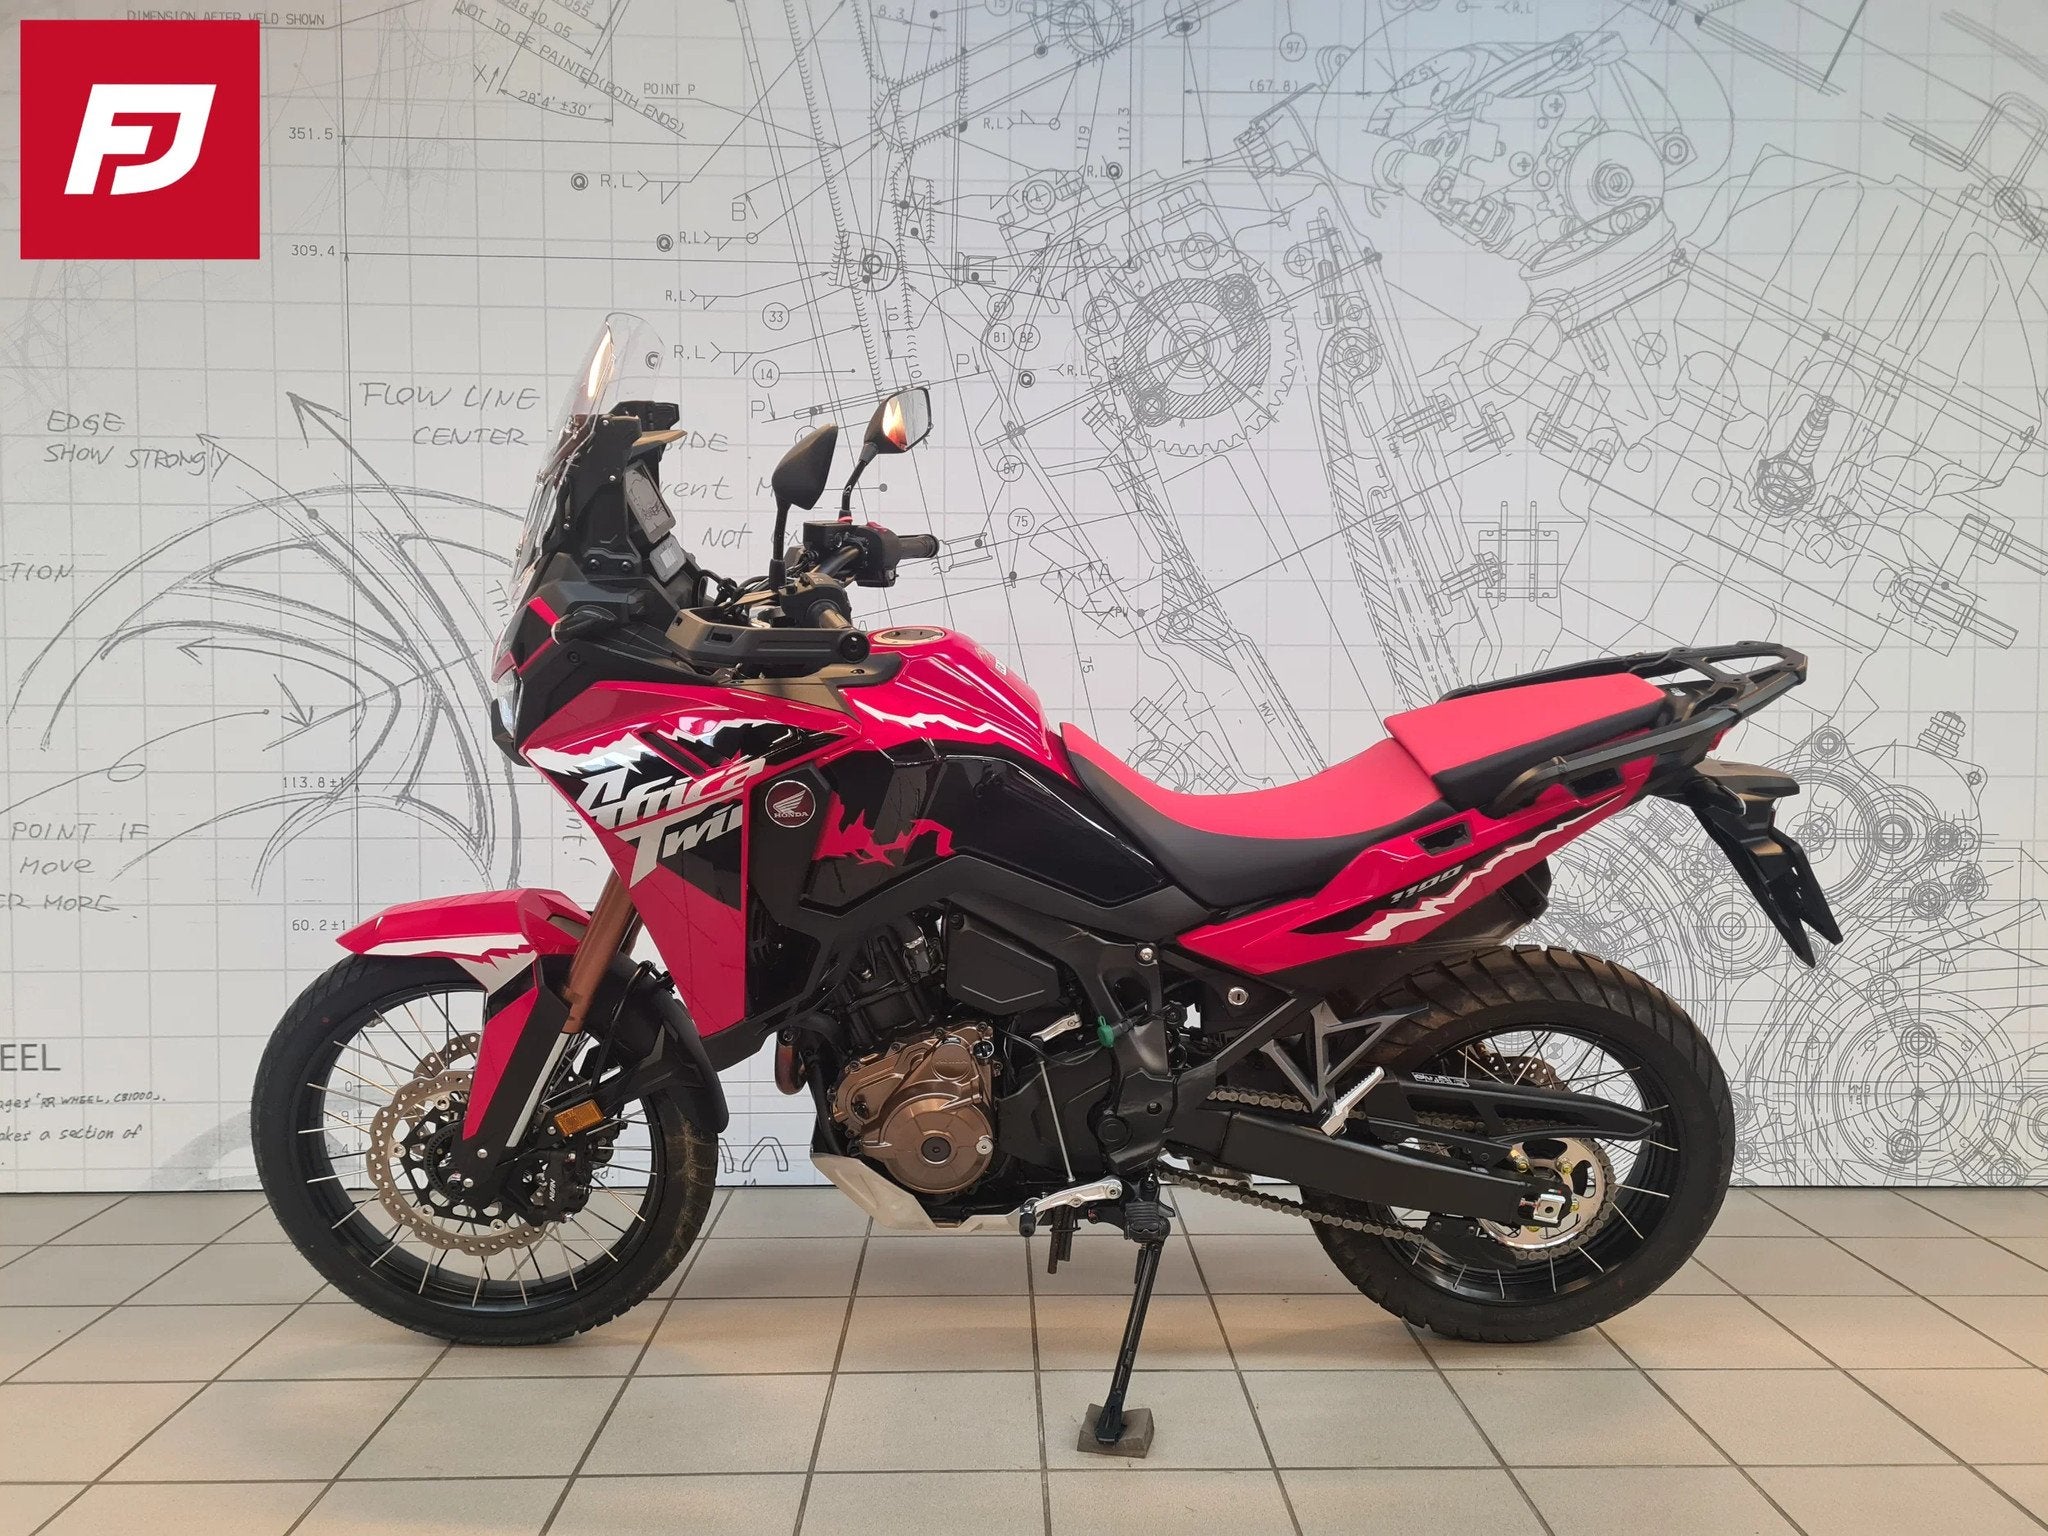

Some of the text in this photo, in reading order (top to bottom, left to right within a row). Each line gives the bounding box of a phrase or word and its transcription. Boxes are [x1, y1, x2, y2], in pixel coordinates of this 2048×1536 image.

[285, 13, 325, 25] SHOWN
[1285, 41, 1300, 55] 97
[458, 1, 487, 20] NOT
[494, 18, 511, 36] TO
[515, 31, 536, 50] BE
[642, 103, 685, 133] ENDS)
[643, 83, 696, 95] POINT P
[288, 127, 334, 141] 351.5
[1076, 126, 1091, 151] 119
[1118, 107, 1130, 151] 117.3
[731, 202, 747, 222] B
[291, 244, 336, 257] 309.4
[768, 310, 784, 323] 33
[993, 333, 1007, 343] 81
[1019, 333, 1034, 343] 82
[956, 353, 970, 373] P
[760, 367, 773, 380] 14
[359, 382, 541, 410] FLOW LINE
[751, 400, 766, 419] P
[47, 410, 125, 435] EDGE
[412, 426, 529, 446] CENTER
[43, 443, 115, 465] SHOW
[1014, 515, 1028, 528] 75
[1081, 656, 1094, 674] 75
[576, 757, 766, 830] Africa
[773, 811, 809, 819] HONDA
[12, 821, 150, 843] POINT IF
[1390, 864, 1463, 904] 1100
[44, 893, 120, 912] MORE
[0, 1043, 61, 1071] EEL
[39, 1130, 51, 1141] a
[58, 1124, 114, 1140] section
[122, 1123, 143, 1139] of
